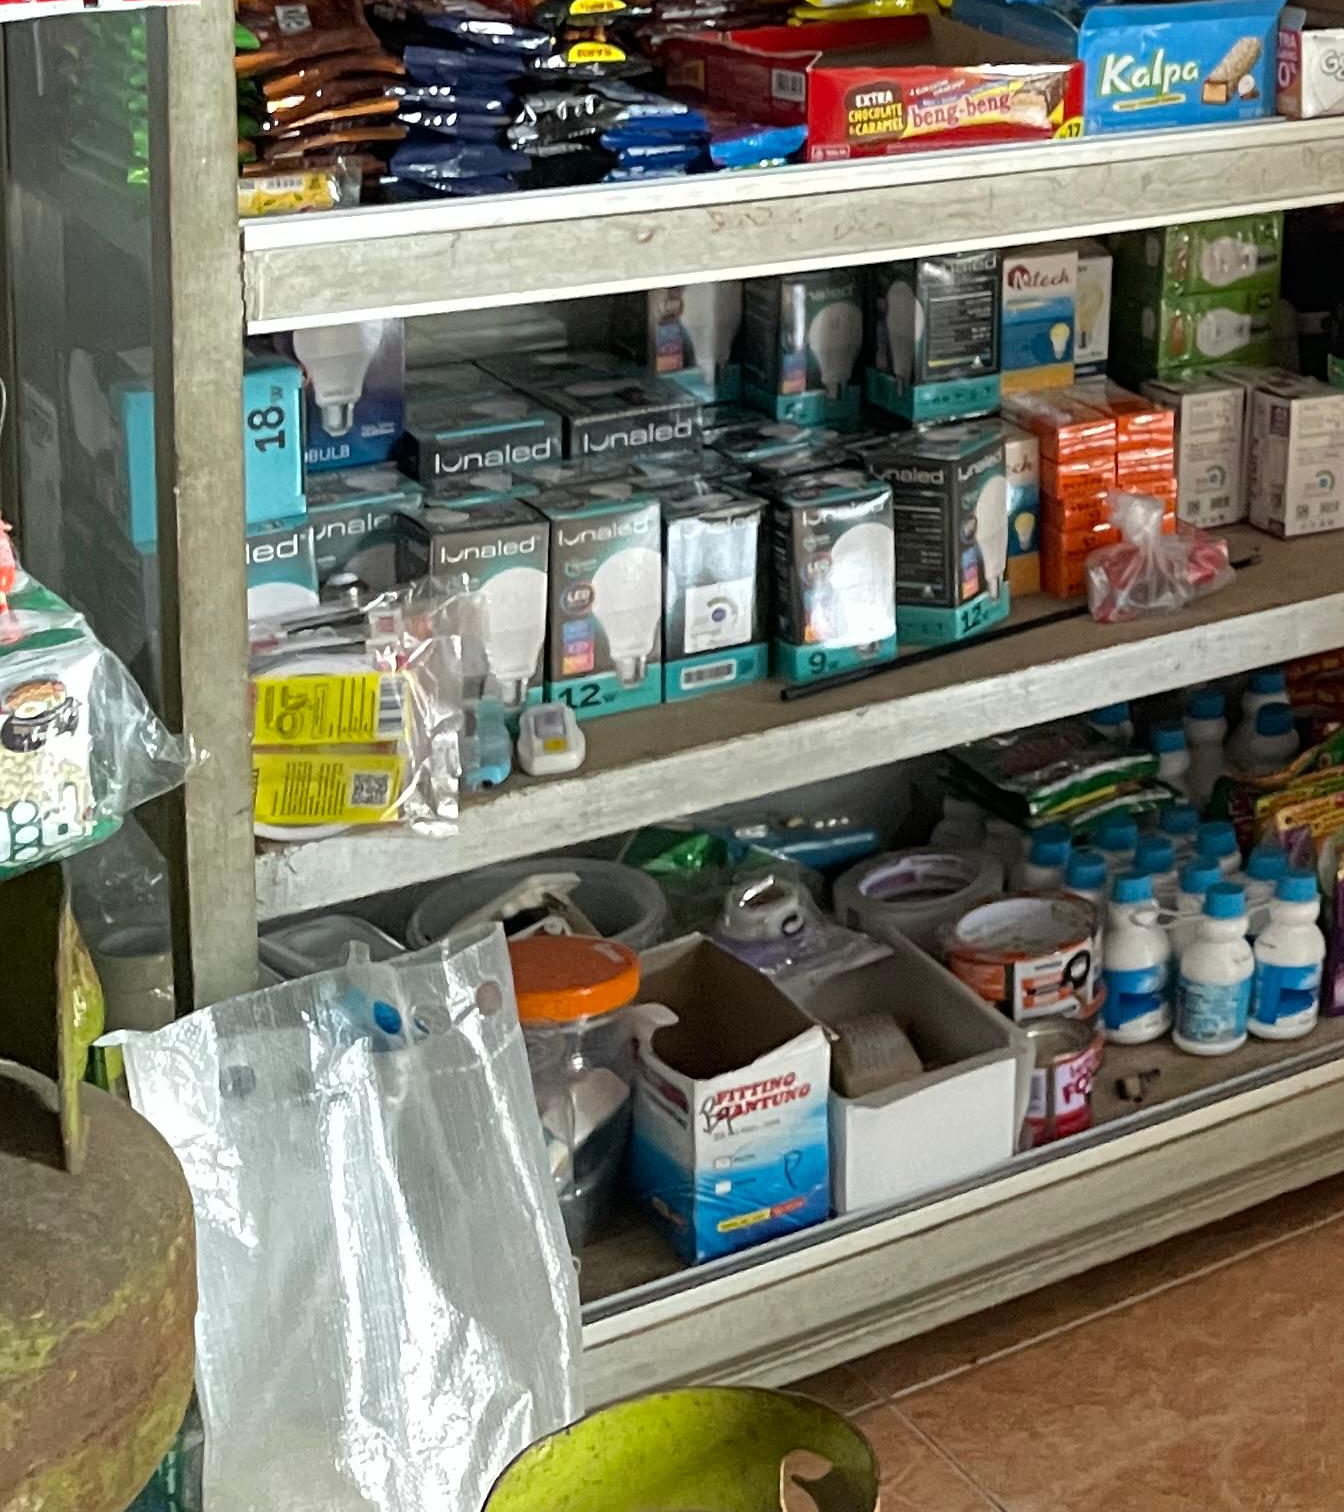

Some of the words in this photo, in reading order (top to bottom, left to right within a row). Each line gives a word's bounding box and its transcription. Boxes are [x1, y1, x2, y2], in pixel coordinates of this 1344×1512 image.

[1099, 49, 1200, 99] Kalpa
[912, 93, 1012, 128] beng-beng
[583, 417, 693, 453] lunaled
[434, 437, 551, 475] lunaled
[440, 535, 536, 564] lunaled
